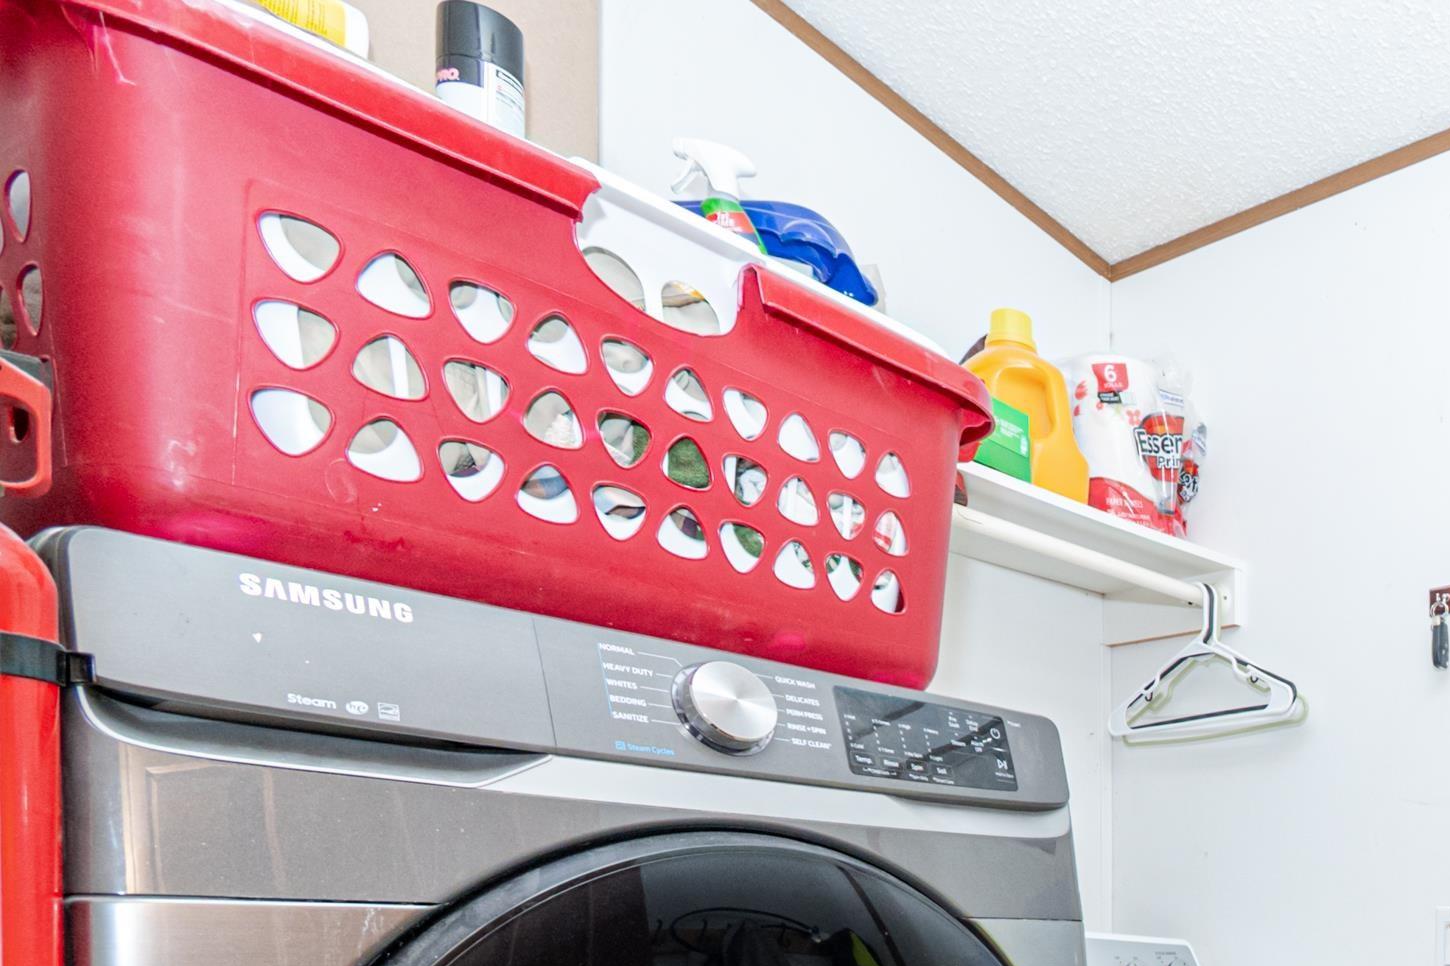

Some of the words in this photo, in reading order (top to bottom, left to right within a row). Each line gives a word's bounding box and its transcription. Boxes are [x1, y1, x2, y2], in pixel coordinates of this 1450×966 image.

[1104, 364, 1117, 382] 6
[239, 573, 414, 623] SAMSUNG
[599, 643, 636, 655] NORMAL
[602, 662, 630, 671] HEAVY
[632, 667, 654, 676] DUTY
[606, 678, 638, 690] WHITES
[287, 693, 337, 709] Steam
[609, 694, 648, 707] BEDDING
[612, 711, 649, 723] SANITIZE
